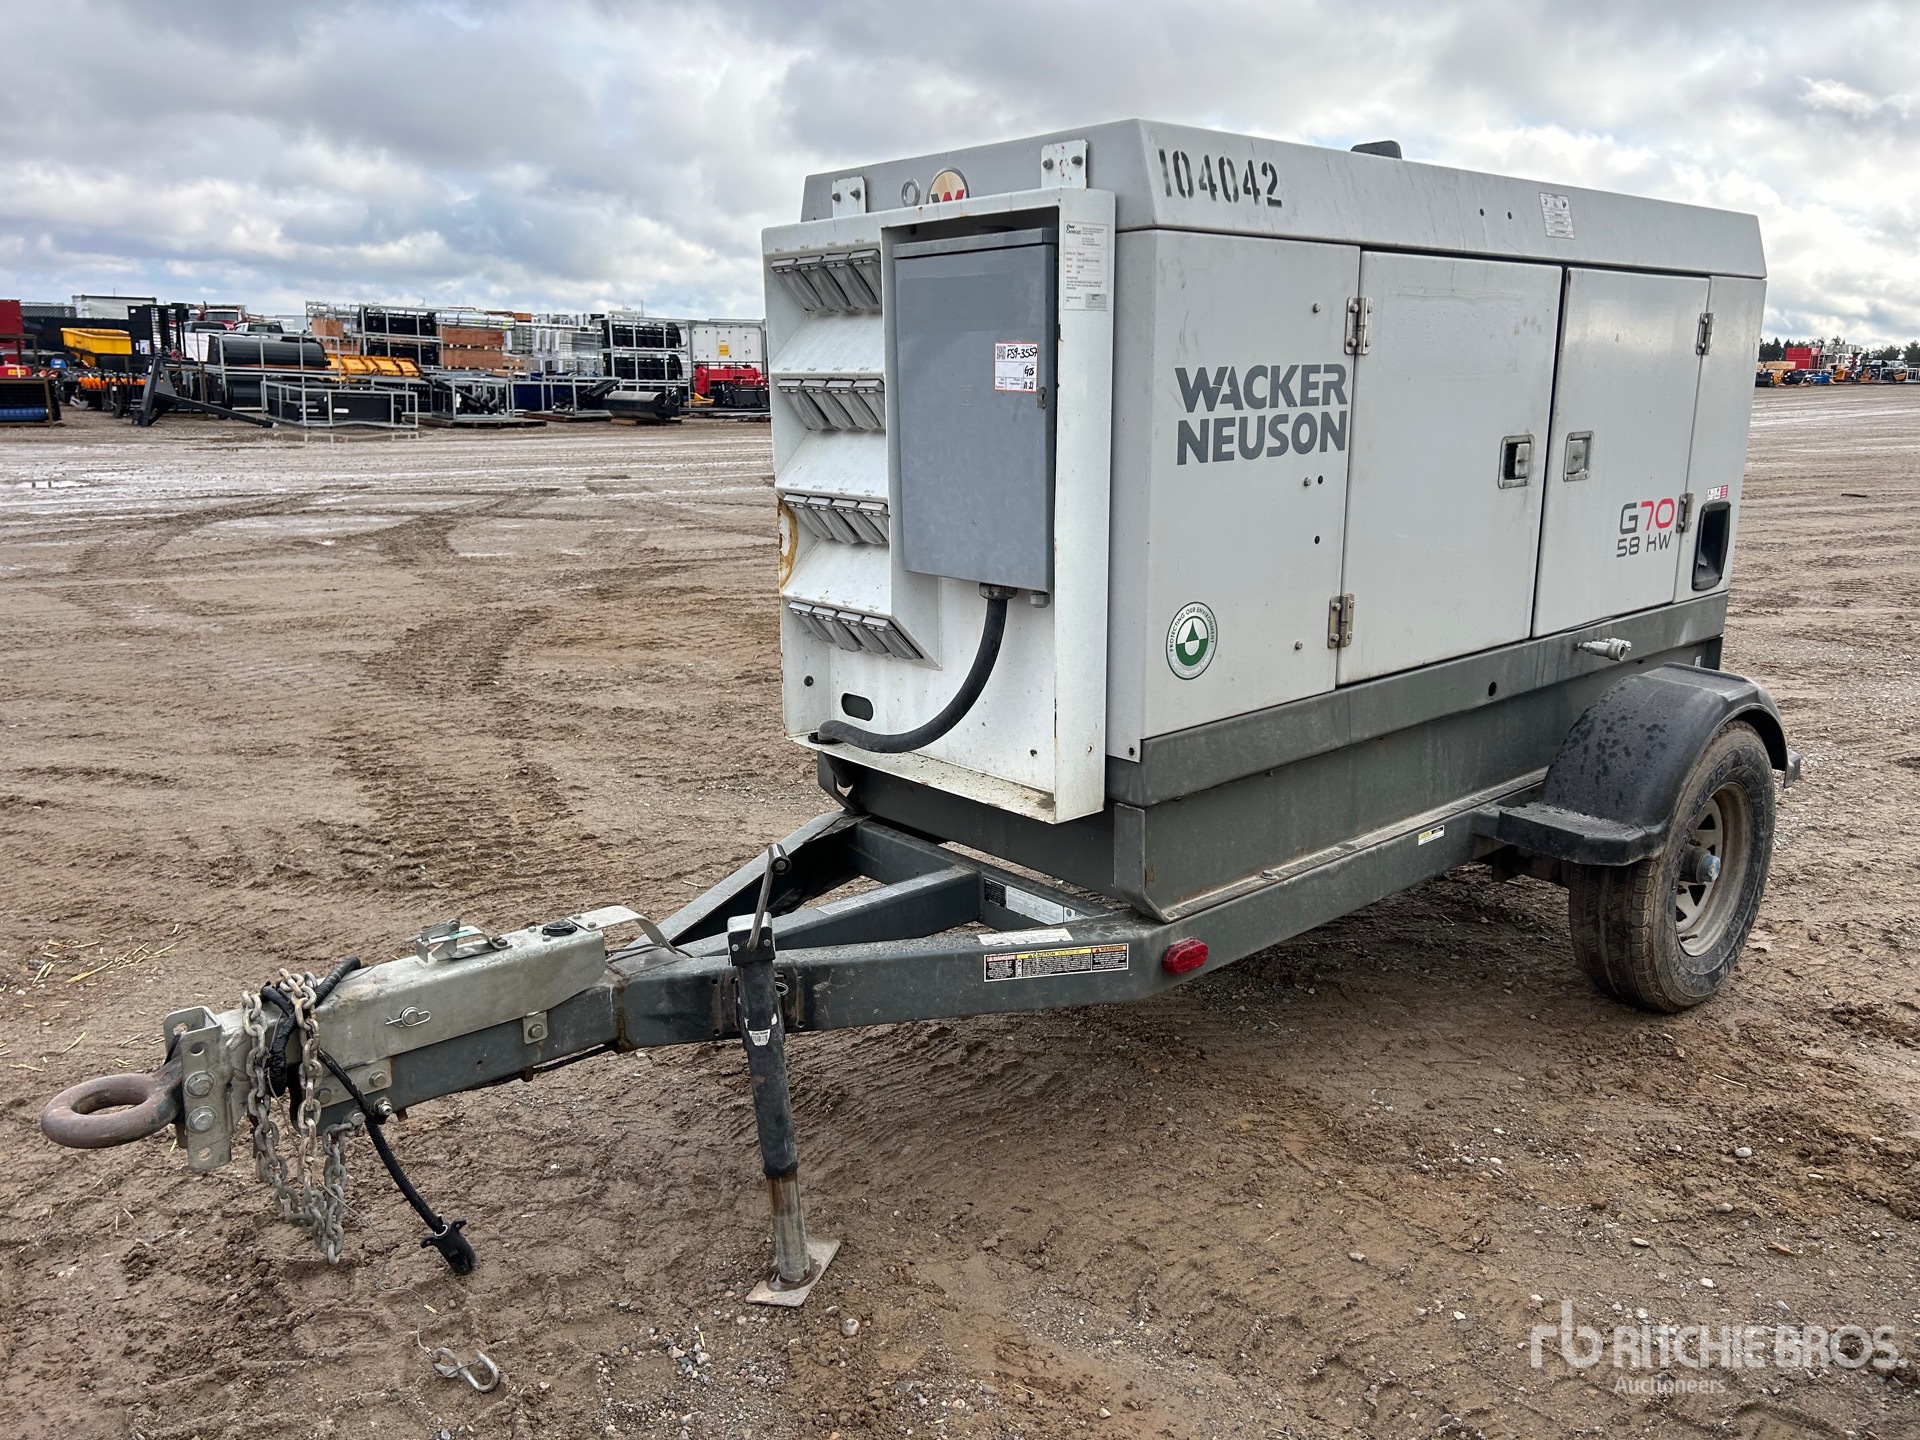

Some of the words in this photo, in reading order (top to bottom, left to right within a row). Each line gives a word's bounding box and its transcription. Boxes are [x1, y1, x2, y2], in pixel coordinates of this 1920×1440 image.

[1159, 149, 1282, 208] 104042
[1174, 363, 1348, 413] WACKER
[1177, 410, 1347, 465] NEUSON
[1620, 498, 1675, 535] G70
[1616, 536, 1640, 558] 58
[1169, 612, 1185, 652] PROTECTING
[1185, 607, 1195, 615] OUR
[1197, 607, 1215, 643] ENVIRONMENT
